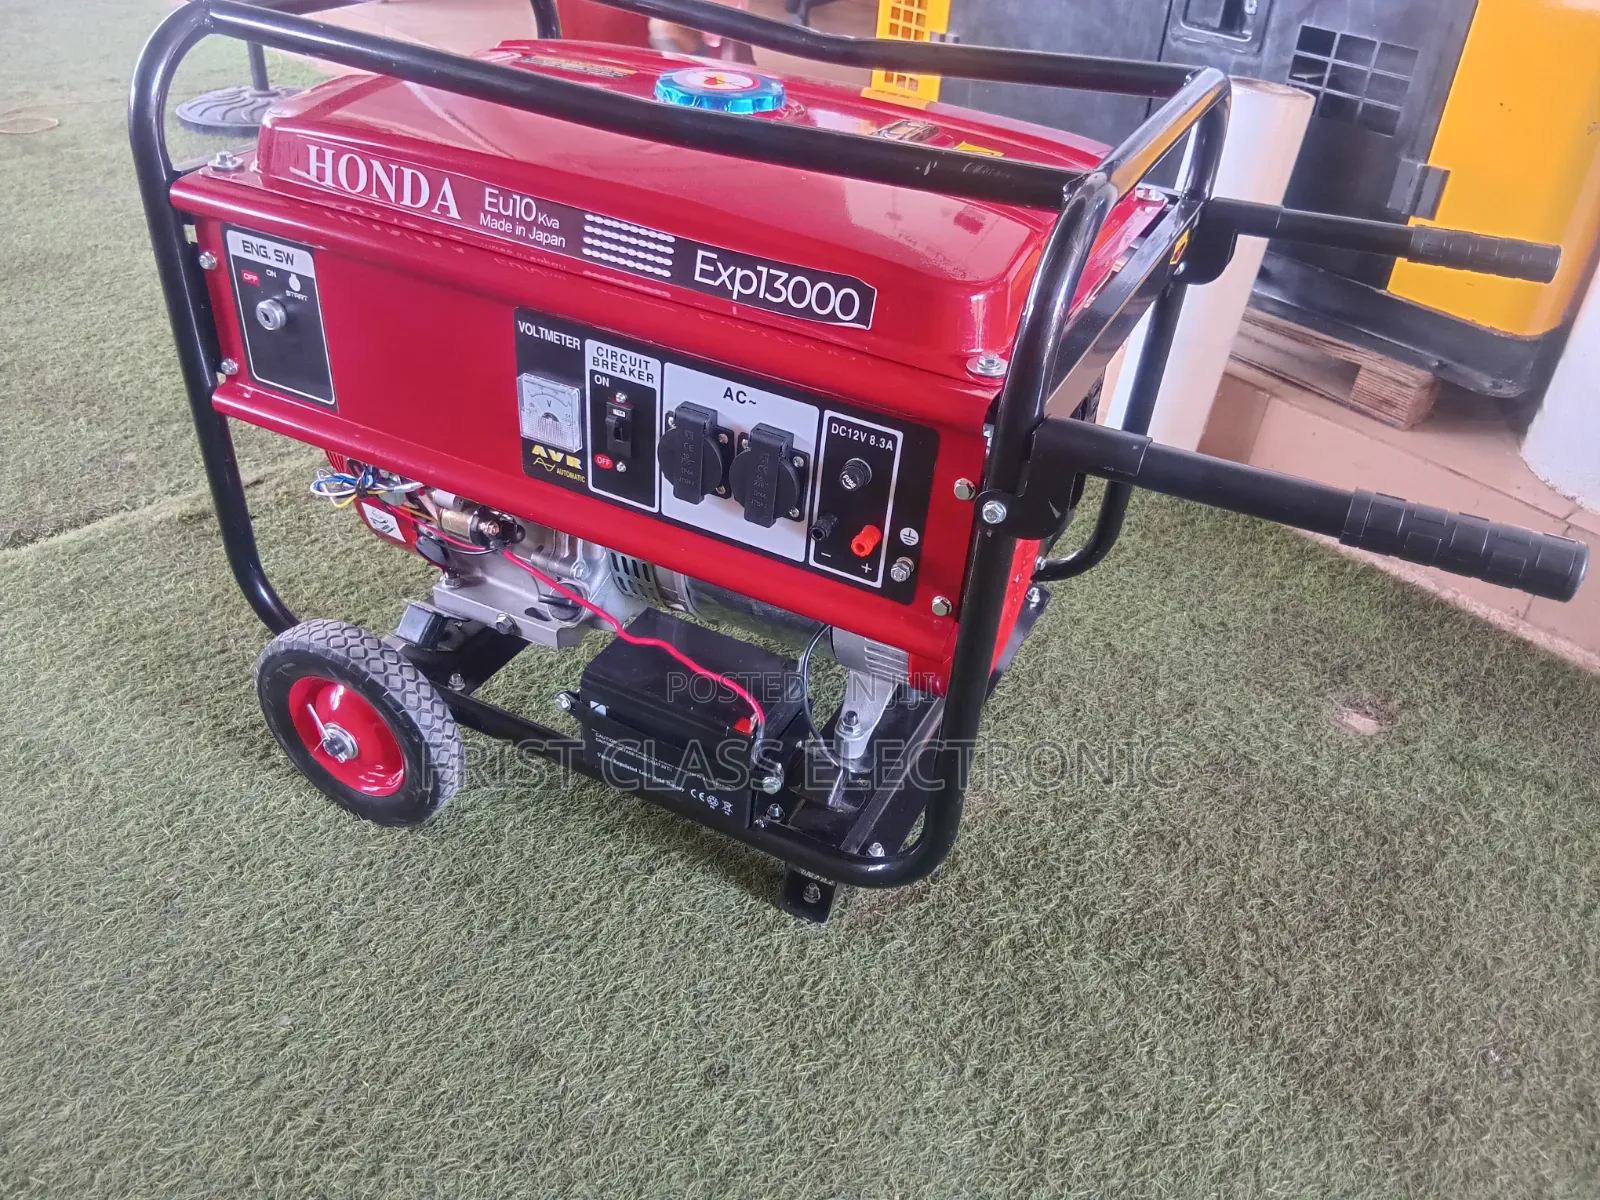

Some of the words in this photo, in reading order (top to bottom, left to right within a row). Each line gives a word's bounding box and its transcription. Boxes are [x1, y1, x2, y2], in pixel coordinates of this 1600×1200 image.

[306, 144, 462, 220] HONDA
[485, 187, 537, 222] Eu10
[537, 214, 560, 230] Kva
[479, 212, 512, 234] Made
[515, 220, 526, 237] in
[528, 226, 566, 249] Japan
[241, 239, 271, 260] ENG.
[273, 249, 294, 267] SW
[243, 272, 258, 283] OFF
[266, 269, 277, 278] ON
[693, 249, 860, 321] Exp13000
[285, 290, 308, 302] START
[517, 320, 581, 350] VOLTMETER
[592, 356, 655, 384] BREAKER
[596, 346, 651, 371] CIRCUIT
[594, 374, 610, 387] ON
[546, 399, 552, 408] V
[831, 423, 867, 443] DC12V
[869, 434, 894, 451] 8.3A
[531, 444, 583, 470] AVR
[597, 457, 611, 467] OFF
[556, 467, 586, 483] AUTOMATIC
[842, 474, 857, 489] FUSE
